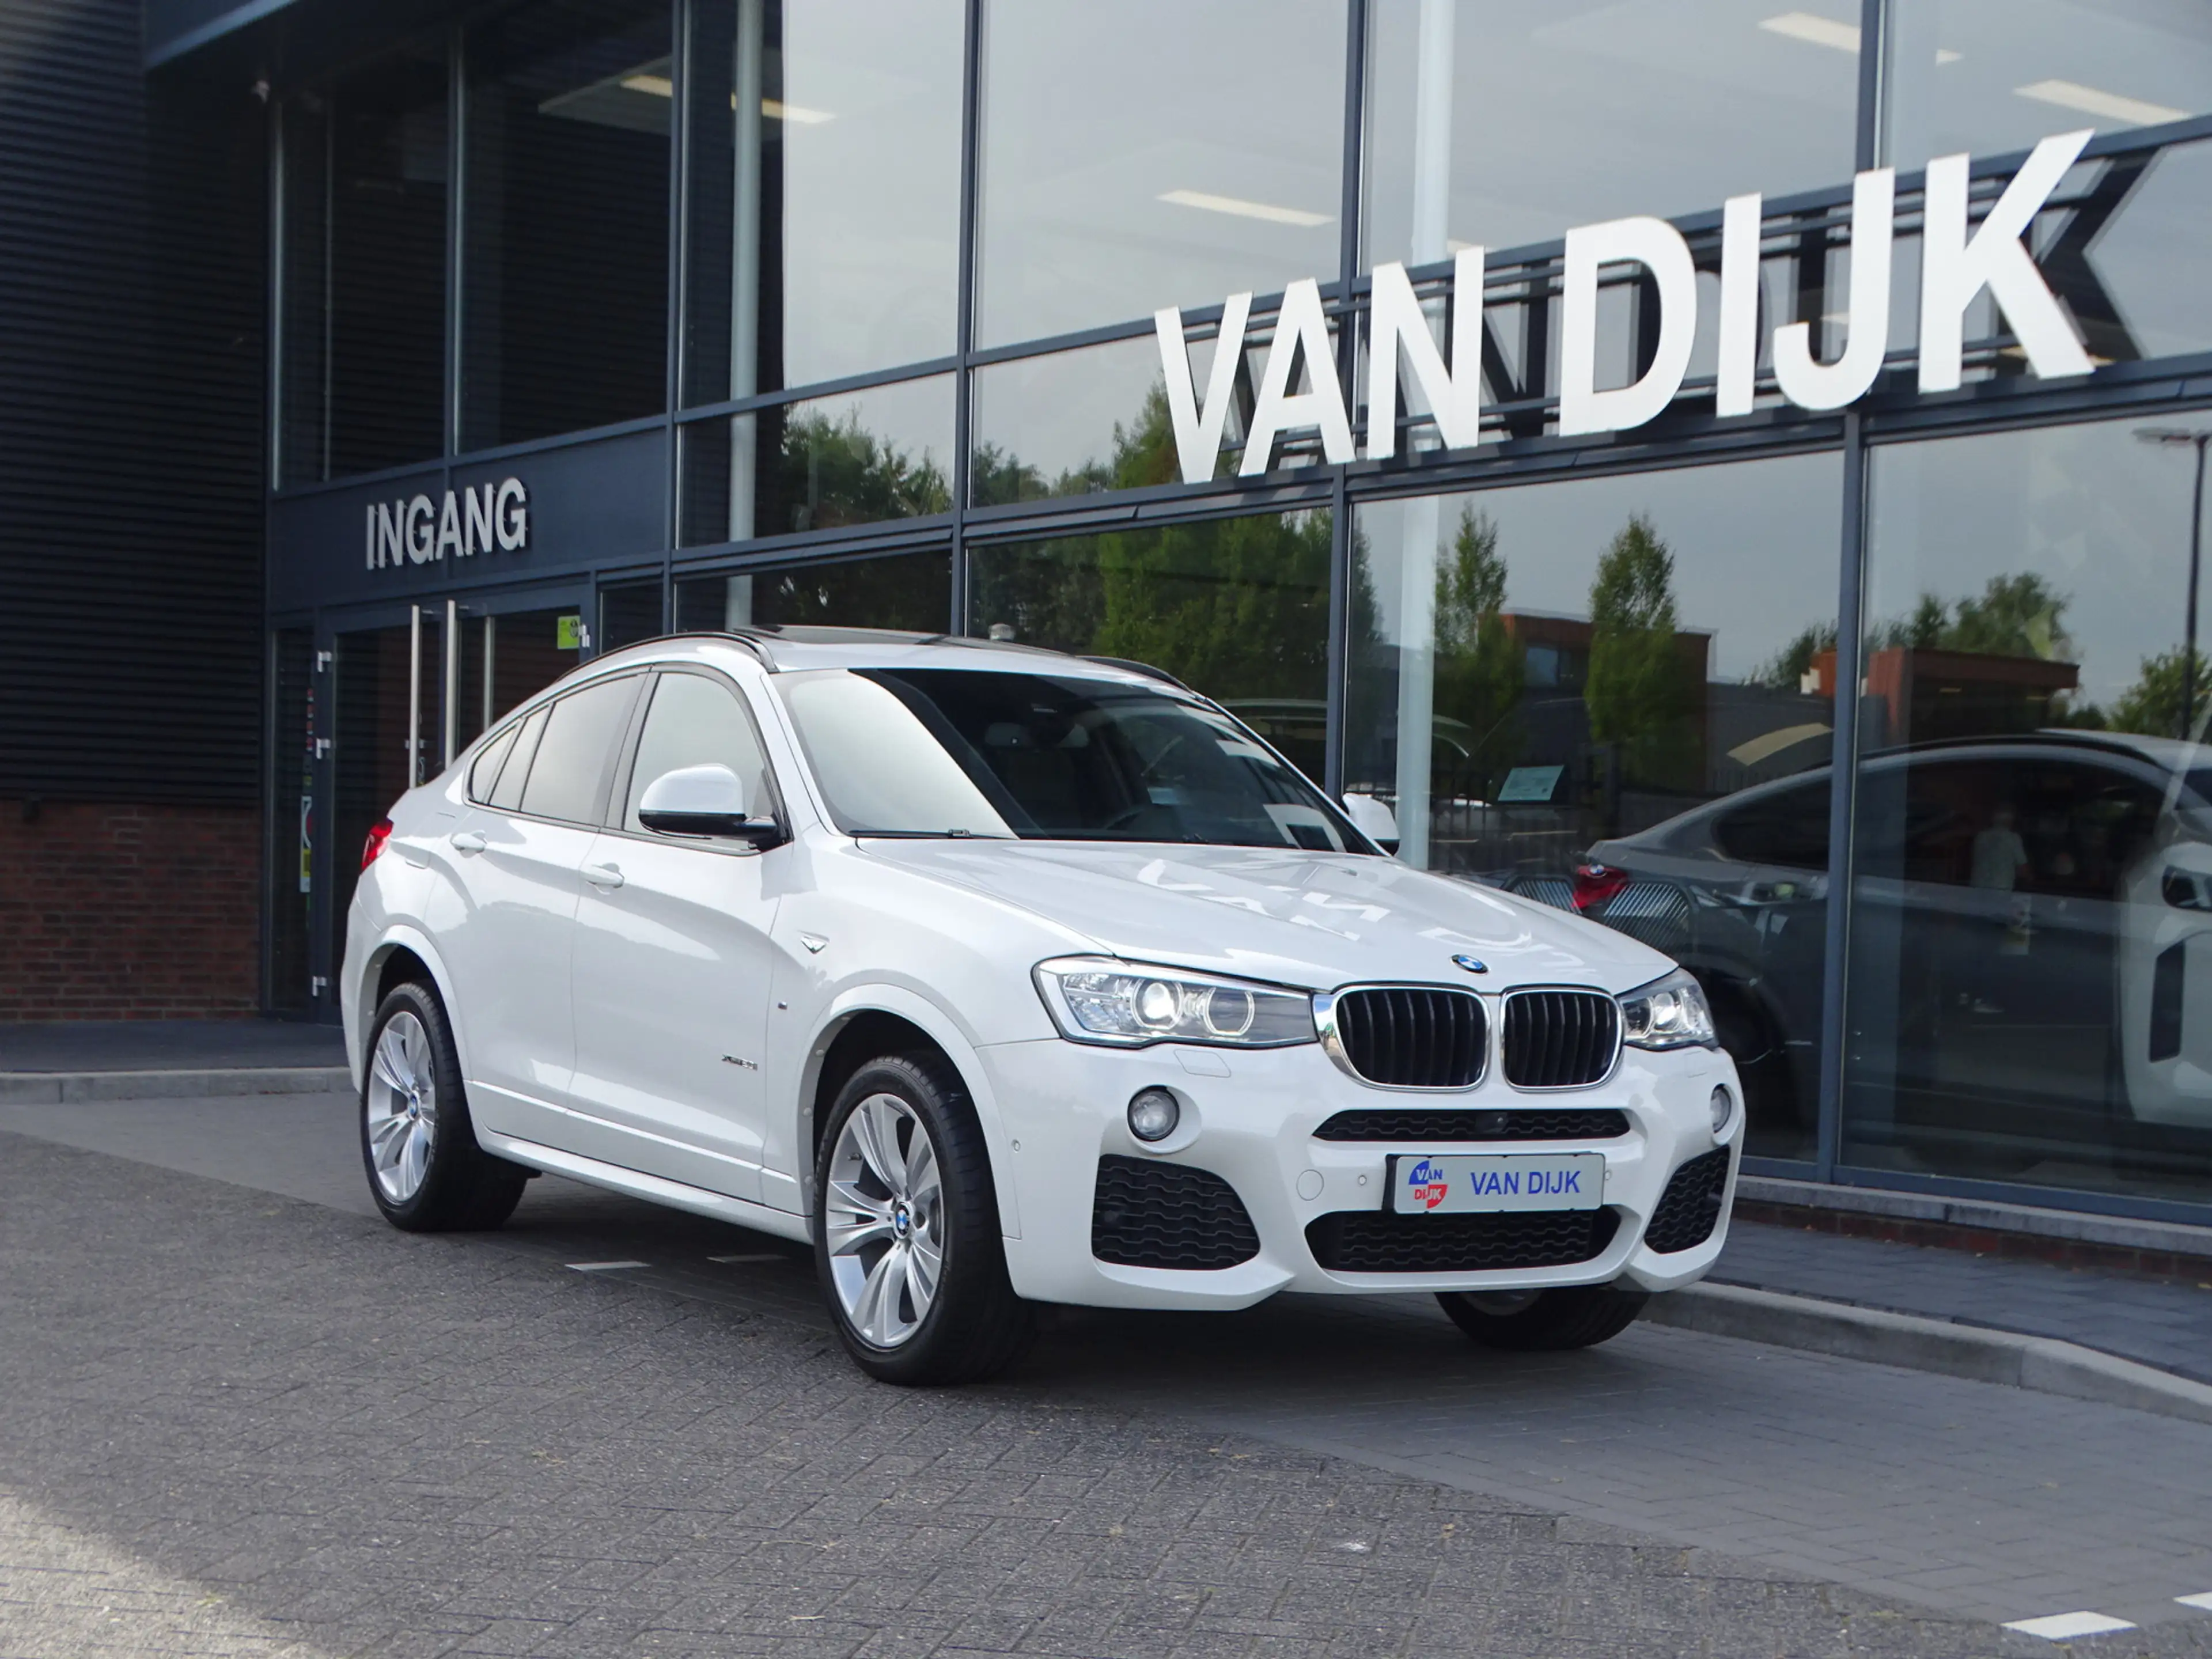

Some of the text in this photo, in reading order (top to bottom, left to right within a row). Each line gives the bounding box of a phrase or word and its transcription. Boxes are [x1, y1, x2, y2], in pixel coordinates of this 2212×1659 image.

[1154, 128, 2095, 484] VAN DIJK
[366, 476, 528, 570] INGANG
[1416, 1169, 1443, 1180] VAN
[1471, 1170, 1581, 1195] VAN DIJK
[1414, 1188, 1442, 1200] DIJK
